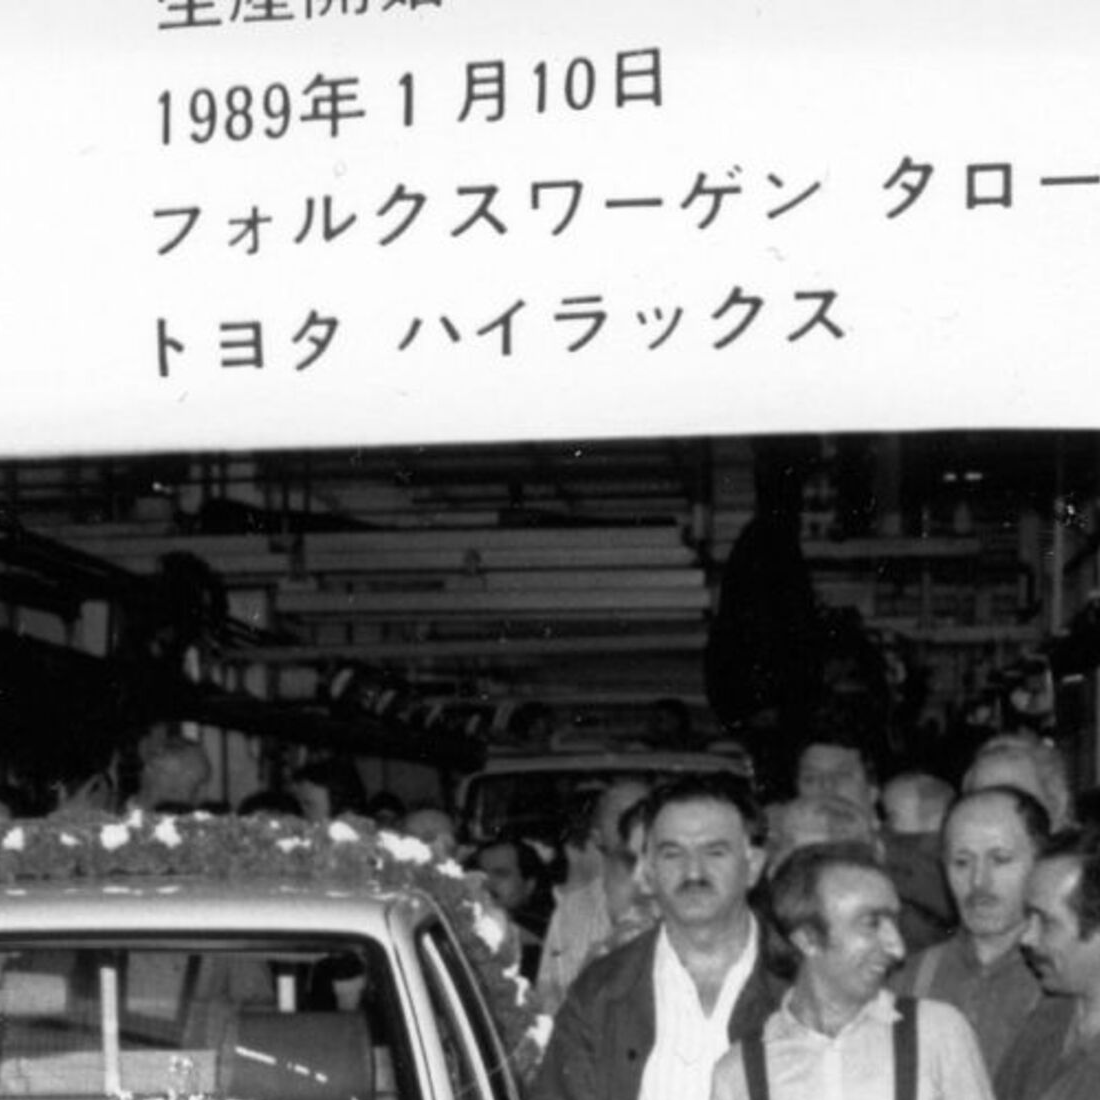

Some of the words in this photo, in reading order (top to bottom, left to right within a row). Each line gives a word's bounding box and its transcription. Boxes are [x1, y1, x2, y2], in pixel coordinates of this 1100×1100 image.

[153, 168, 821, 256] フォルクスワーゲン
[157, 310, 338, 377] トヨタ
[399, 286, 843, 356] ハイラックス
